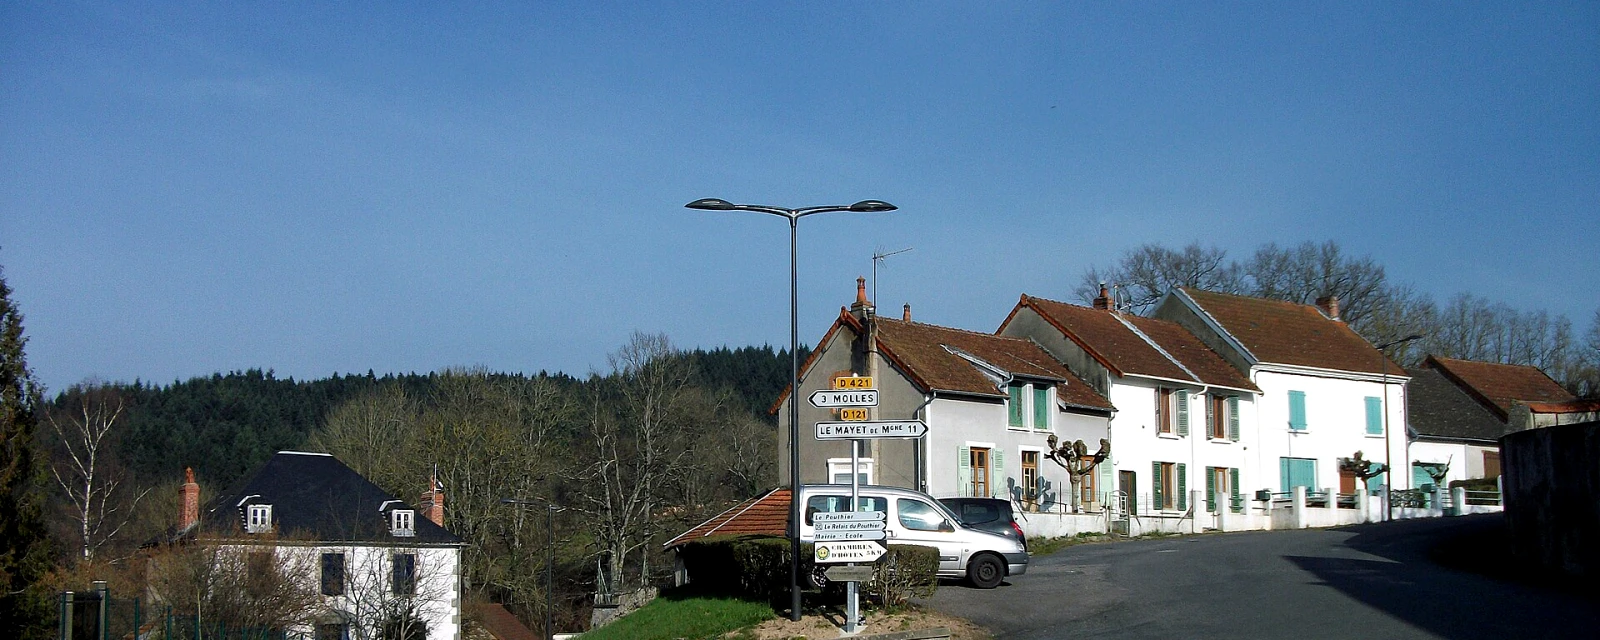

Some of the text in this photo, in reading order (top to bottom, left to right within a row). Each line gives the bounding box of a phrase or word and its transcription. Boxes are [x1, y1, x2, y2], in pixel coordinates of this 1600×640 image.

[821, 394, 874, 404] 3 MOLLES
[851, 410, 866, 418] 121
[820, 426, 831, 435] LE
[836, 426, 867, 434] MAYET
[908, 425, 917, 433] 11
